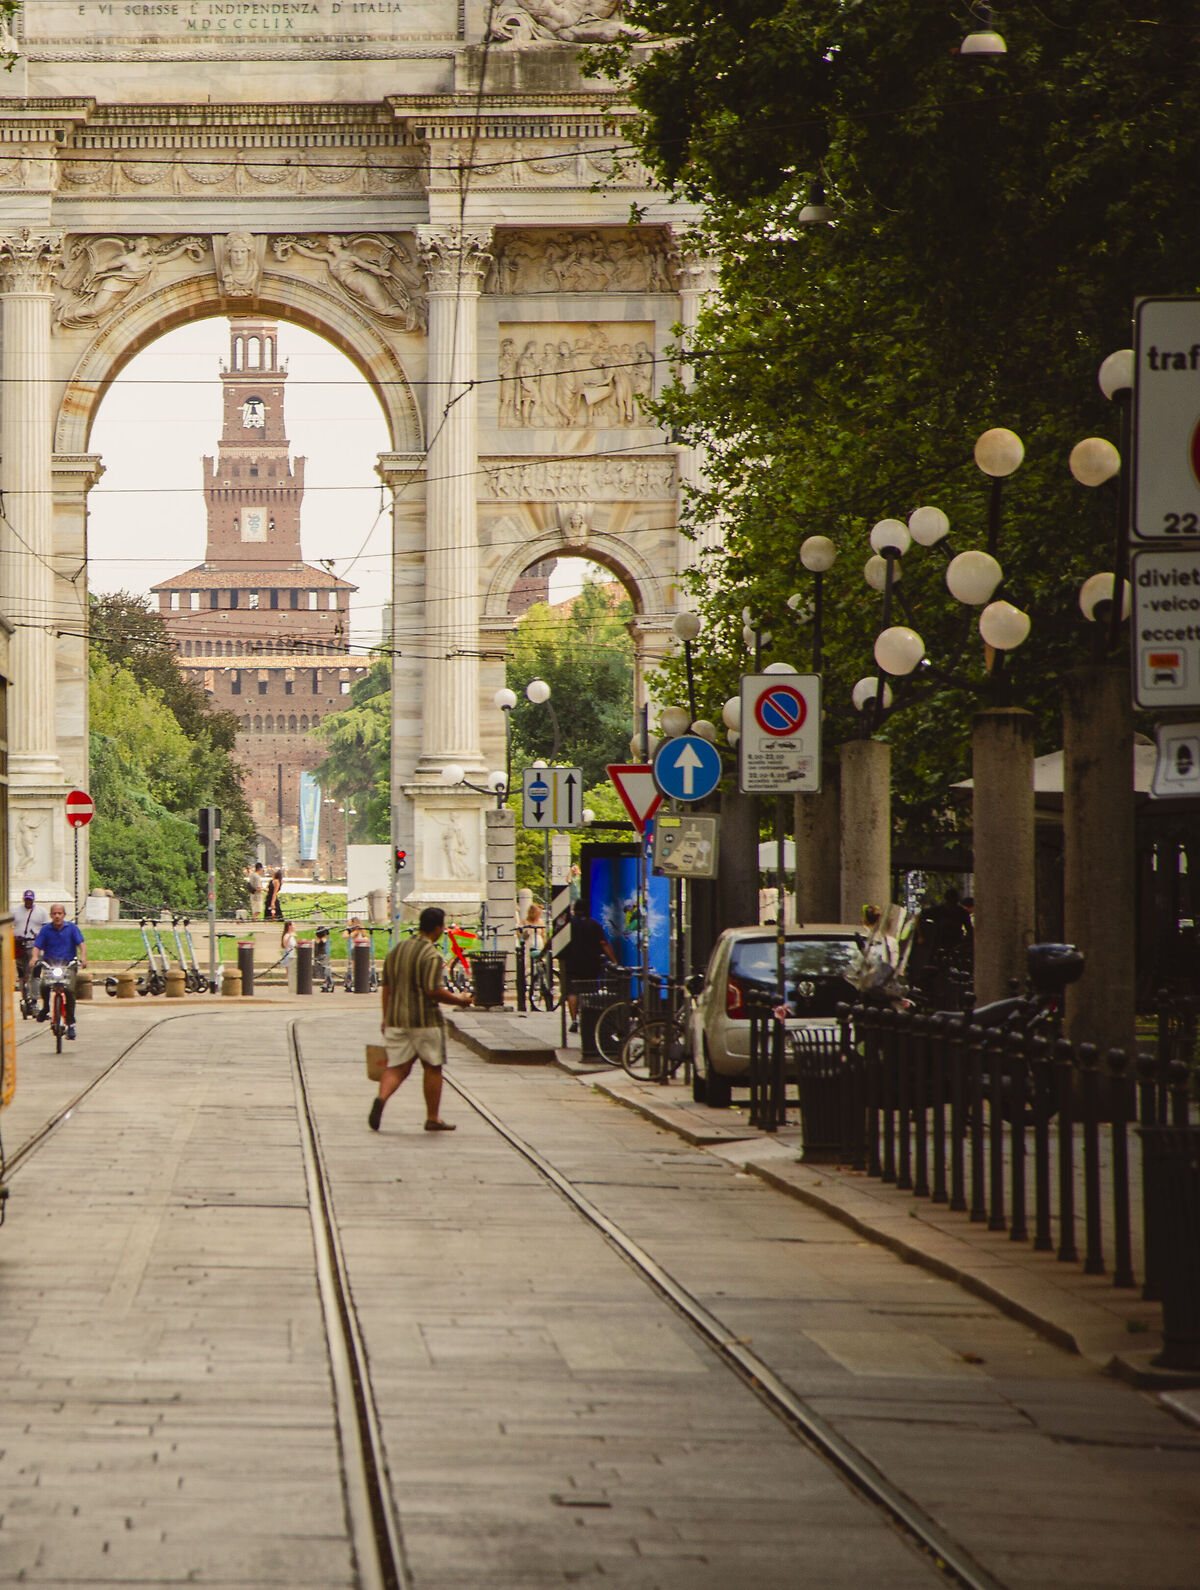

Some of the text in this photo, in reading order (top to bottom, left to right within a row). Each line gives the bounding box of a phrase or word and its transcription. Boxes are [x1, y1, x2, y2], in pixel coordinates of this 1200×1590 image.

[78, 5, 86, 15] E
[99, 5, 113, 15] VI
[124, 4, 178, 15] SCRISSE
[209, 3, 319, 15] INDIPENDENZA
[353, 2, 402, 14] ITALIA
